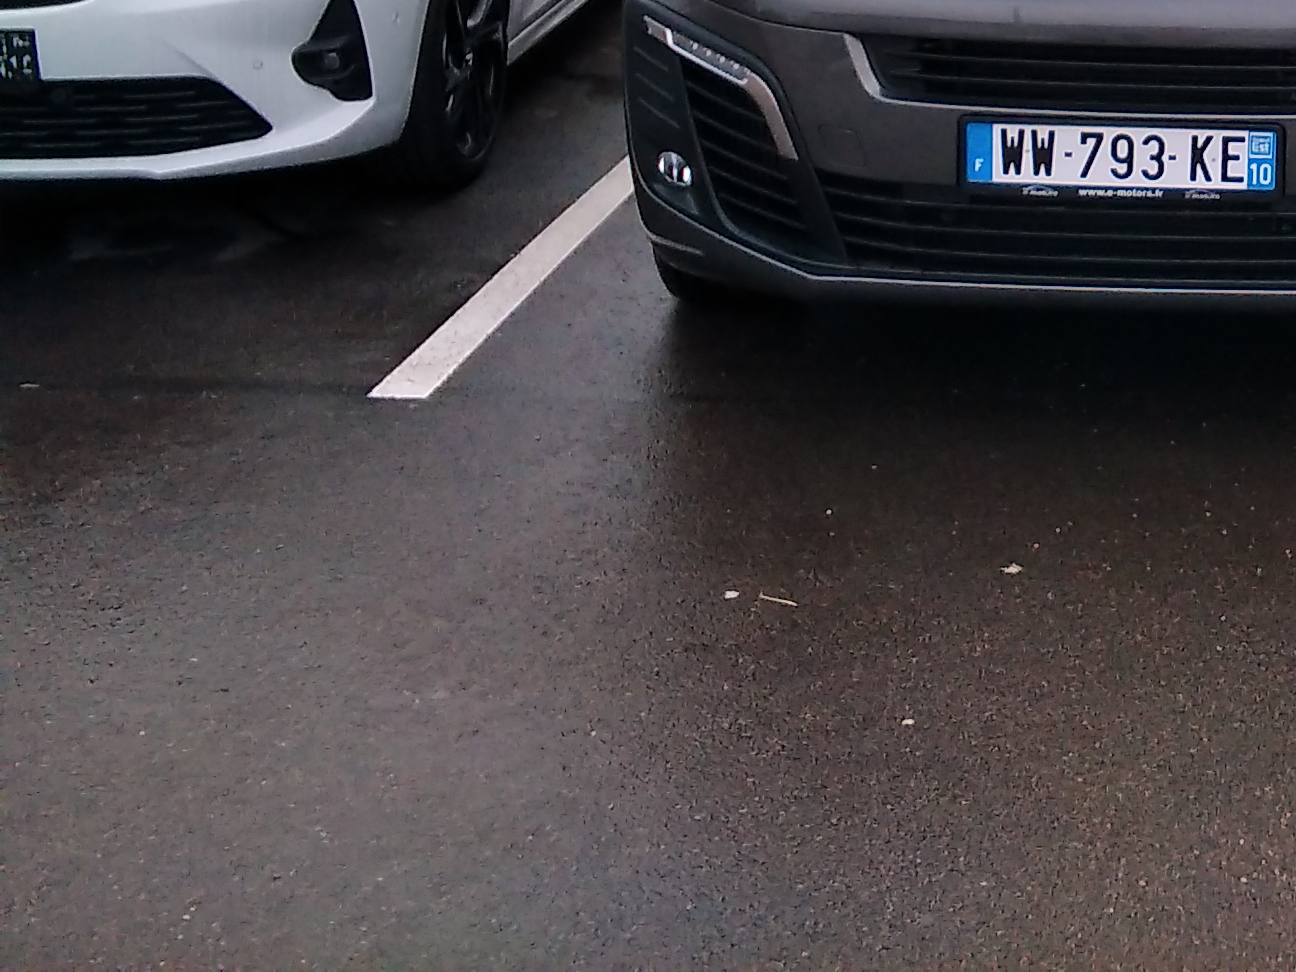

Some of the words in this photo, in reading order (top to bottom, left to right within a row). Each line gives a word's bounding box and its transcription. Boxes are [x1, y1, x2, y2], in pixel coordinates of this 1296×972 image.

[974, 158, 984, 172] F
[1250, 163, 1272, 185] 10
[1078, 188, 1164, 198] www.e-motors.fr
